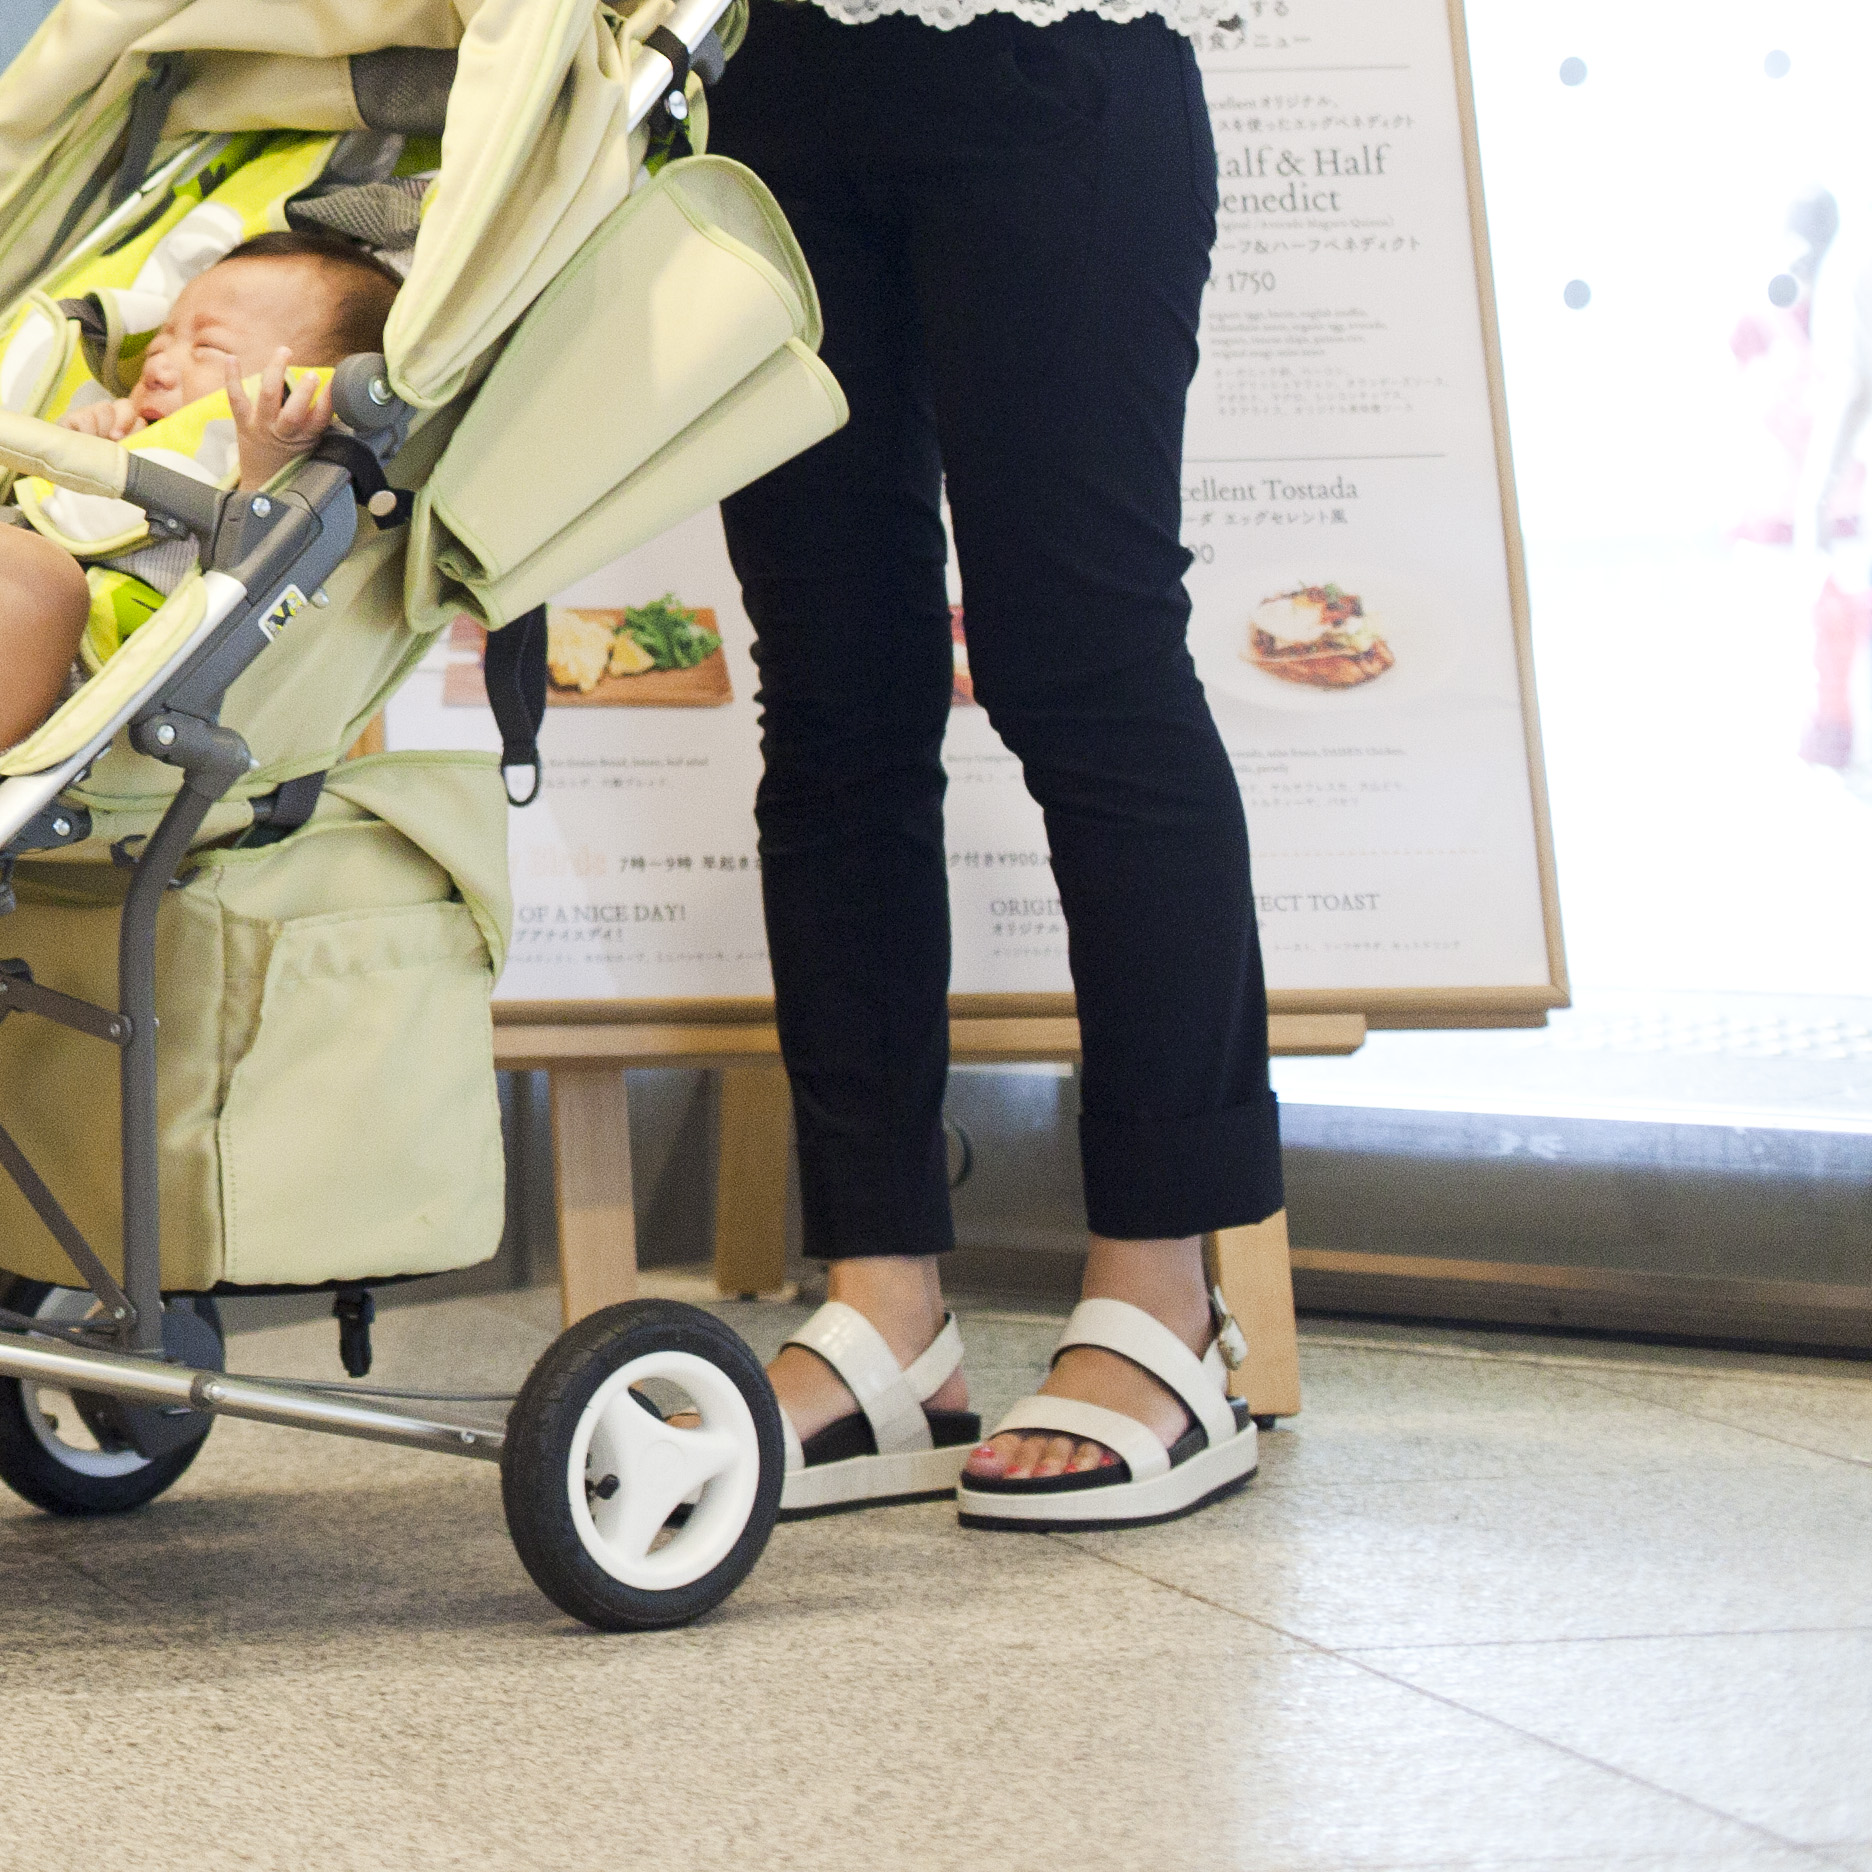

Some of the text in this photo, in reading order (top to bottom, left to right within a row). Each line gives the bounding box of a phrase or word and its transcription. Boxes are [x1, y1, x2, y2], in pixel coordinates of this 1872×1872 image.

[1217, 142, 1392, 179] alf & Half
[1218, 182, 1342, 213] enedict
[1227, 270, 1276, 294] 1750
[1261, 475, 1359, 502] Tostada
[518, 904, 686, 924] OF A NICE DAY!
[1307, 893, 1380, 913] TOAST
